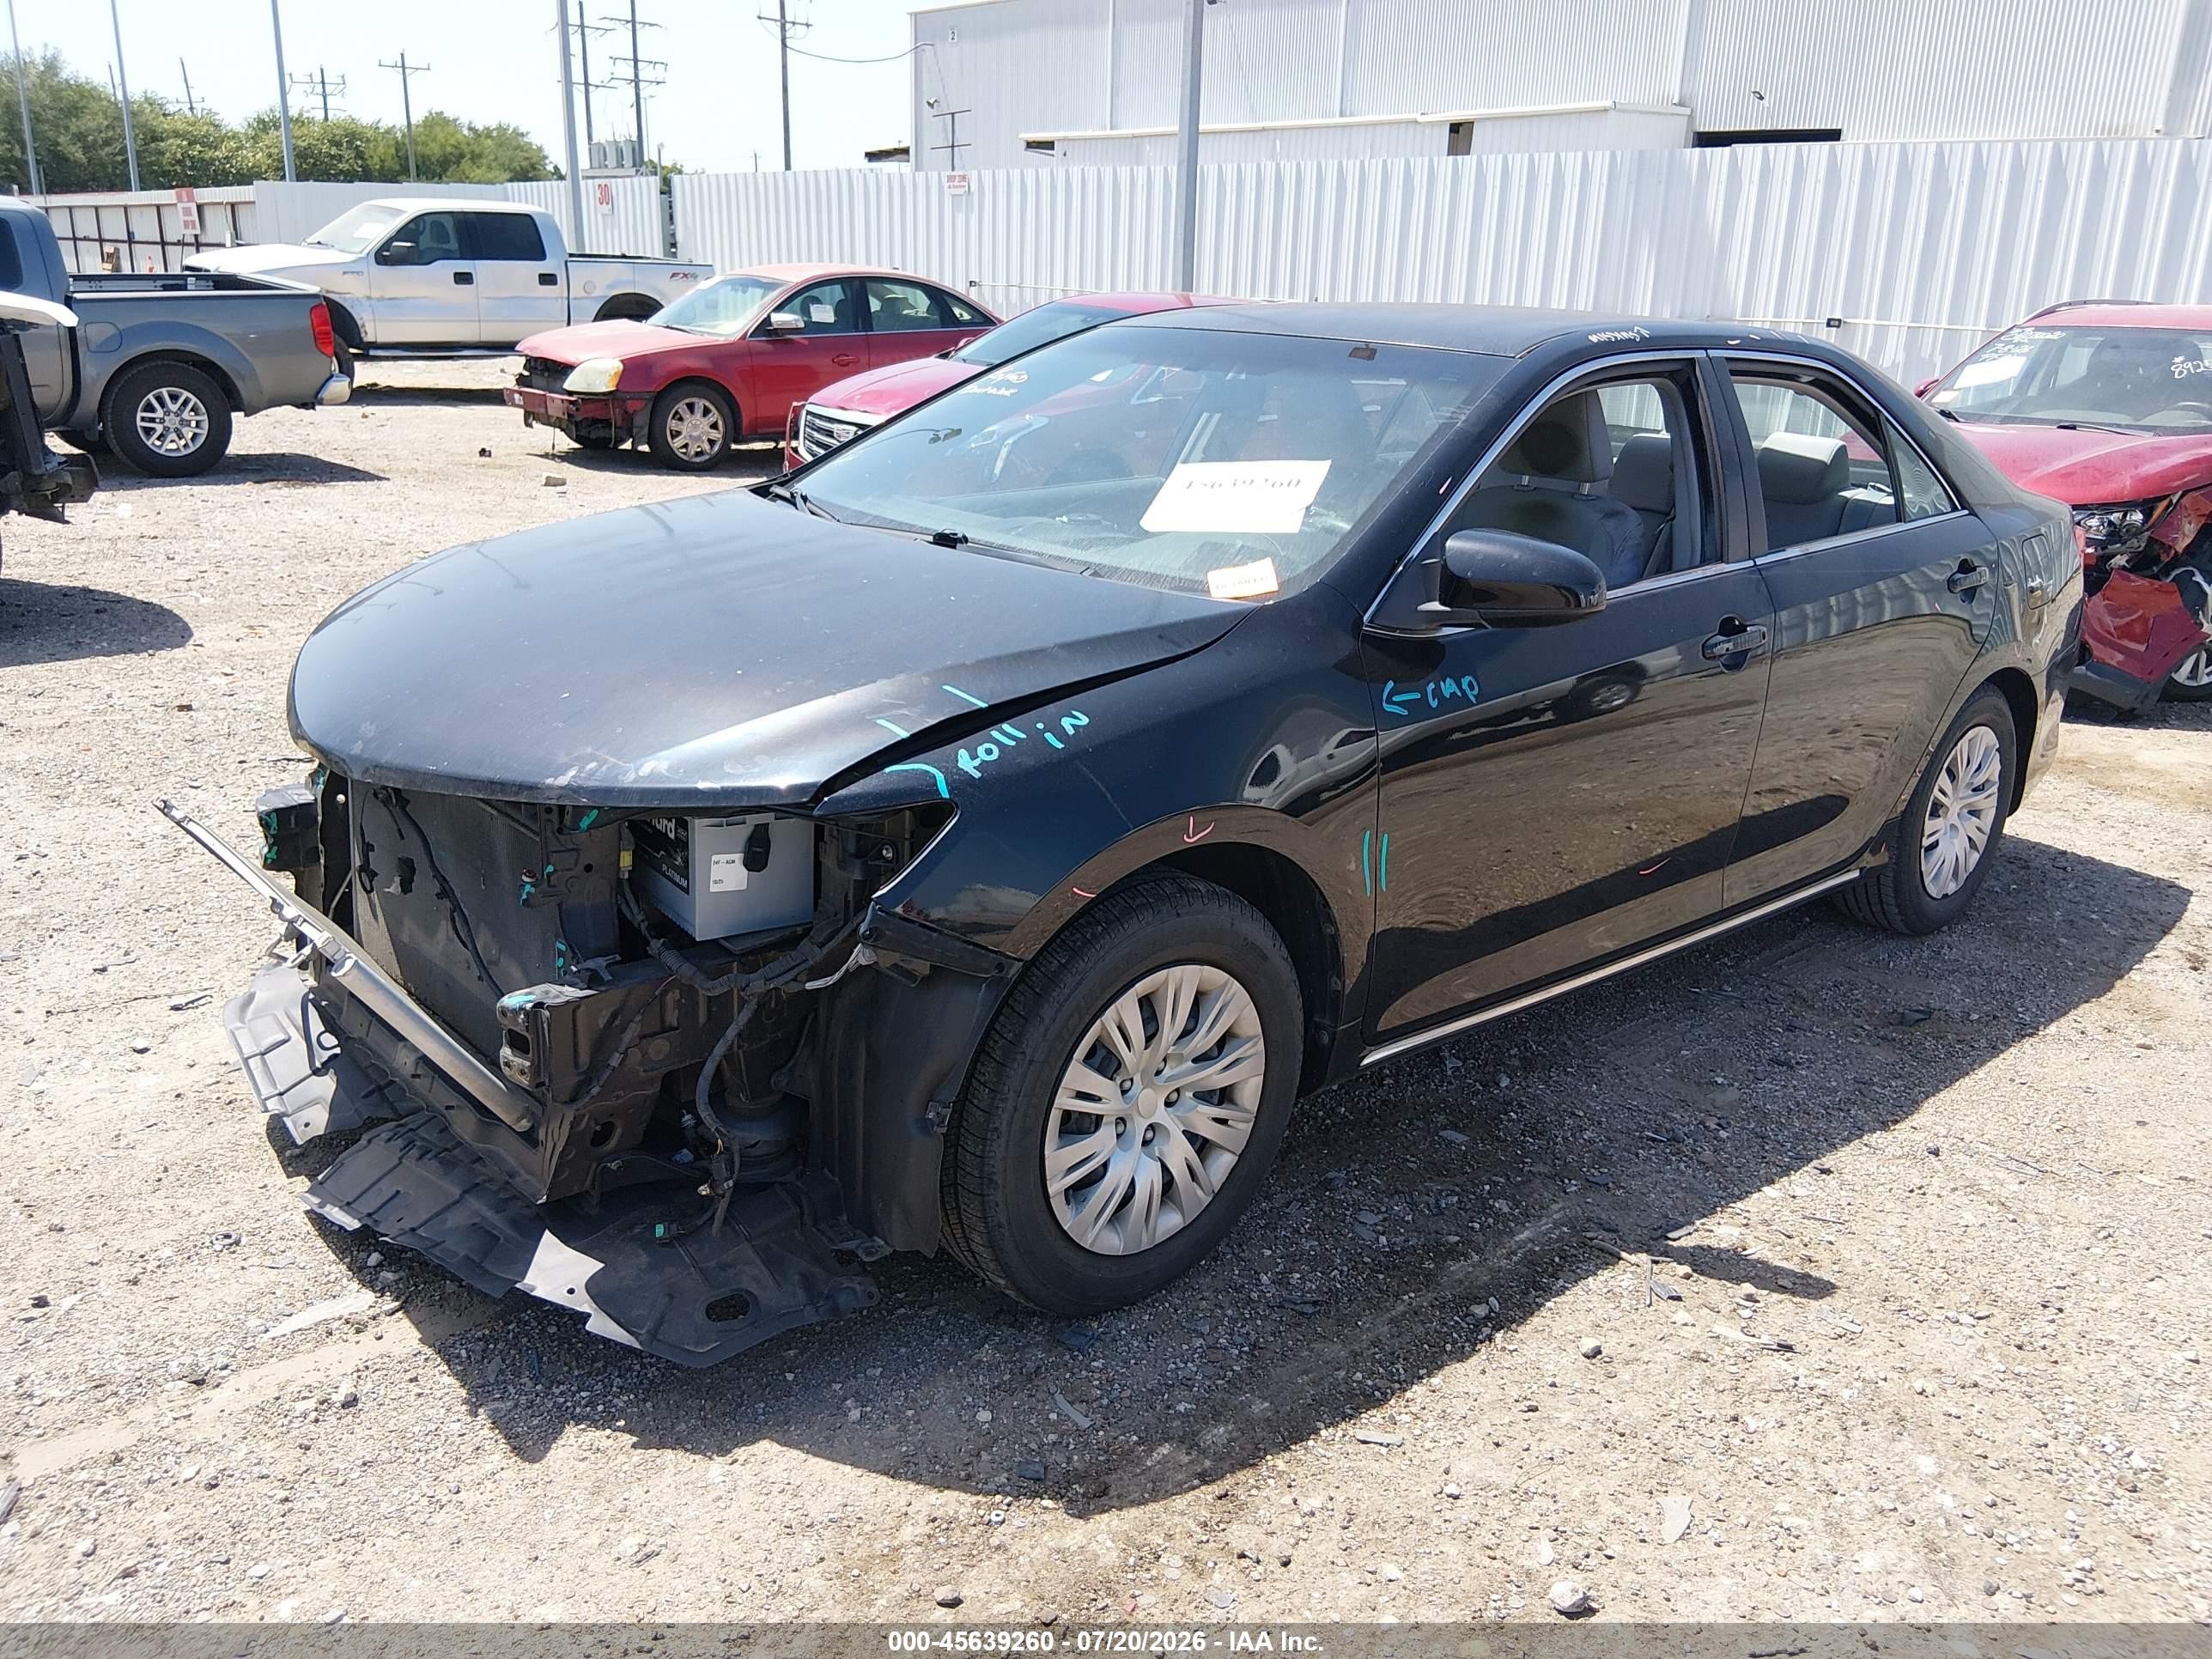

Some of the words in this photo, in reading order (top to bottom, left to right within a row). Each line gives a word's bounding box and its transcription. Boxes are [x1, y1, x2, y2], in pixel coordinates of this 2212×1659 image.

[950, 31, 956, 40] 2
[598, 184, 610, 205] 30
[661, 863, 688, 889] PLATINUM
